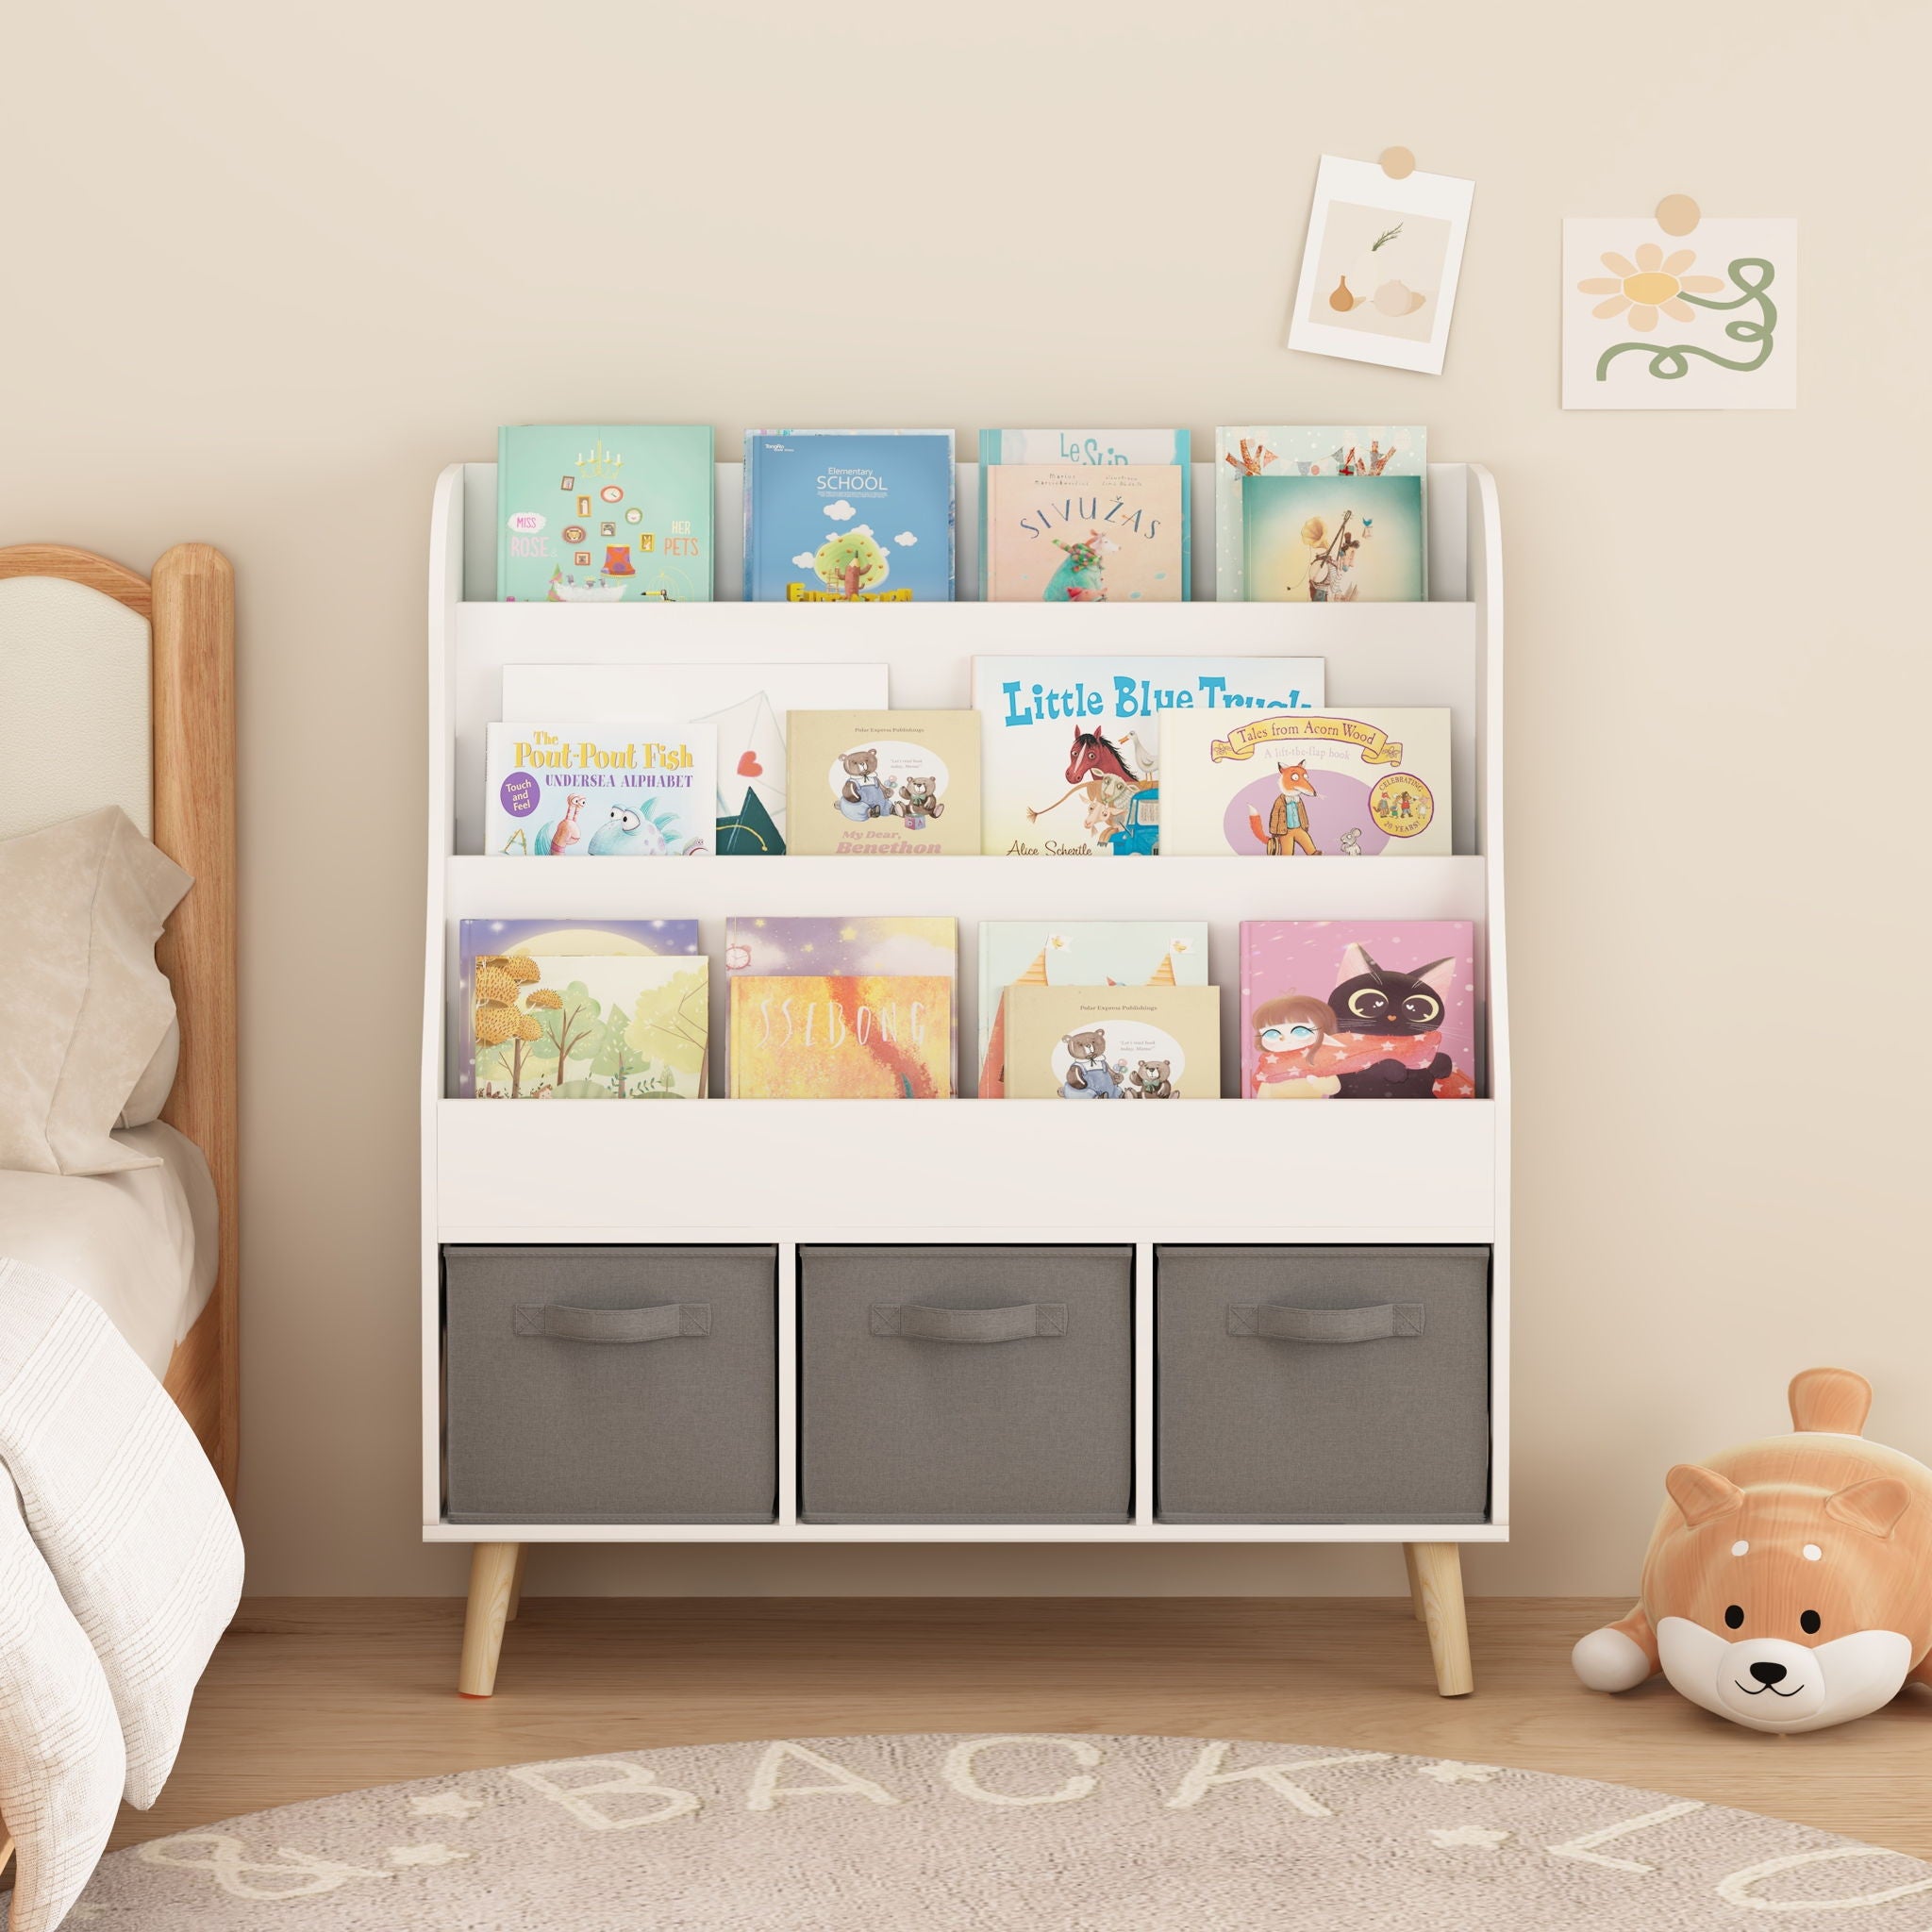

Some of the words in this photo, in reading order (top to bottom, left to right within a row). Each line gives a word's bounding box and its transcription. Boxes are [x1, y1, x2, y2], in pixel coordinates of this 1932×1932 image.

[1060, 433, 1080, 462] Le
[816, 475, 889, 491] SCHOOL
[516, 517, 537, 528] MISS
[1020, 495, 1161, 540] SIVUŽAS
[672, 521, 691, 535] HER
[510, 536, 550, 558] ROSE
[664, 538, 699, 556] PETS
[1002, 680, 1104, 727] Little
[1113, 675, 1193, 718] Blue
[533, 730, 558, 745] The
[1237, 727, 1268, 743] Tales
[1272, 722, 1299, 736] from
[1305, 720, 1339, 736] Acorn
[1342, 723, 1376, 745] Wood
[513, 741, 638, 770] Pout-Pout
[642, 742, 695, 771] Fish
[1264, 748, 1273, 759] A
[1274, 745, 1326, 760] lift-the-flap
[1328, 748, 1350, 760] book
[506, 779, 532, 792] Touch
[545, 774, 615, 787] UNDERSEA
[621, 774, 693, 788] ALPHABET
[1379, 775, 1424, 792] CELEBRATING
[512, 791, 529, 802] and
[513, 799, 531, 811] Feel
[842, 830, 863, 840] My
[866, 830, 902, 840] Dear,
[836, 841, 942, 855] Benethon
[1007, 840, 1038, 856] Alice
[1044, 841, 1092, 856] Schertle
[508, 1737, 1394, 1830] BACK
